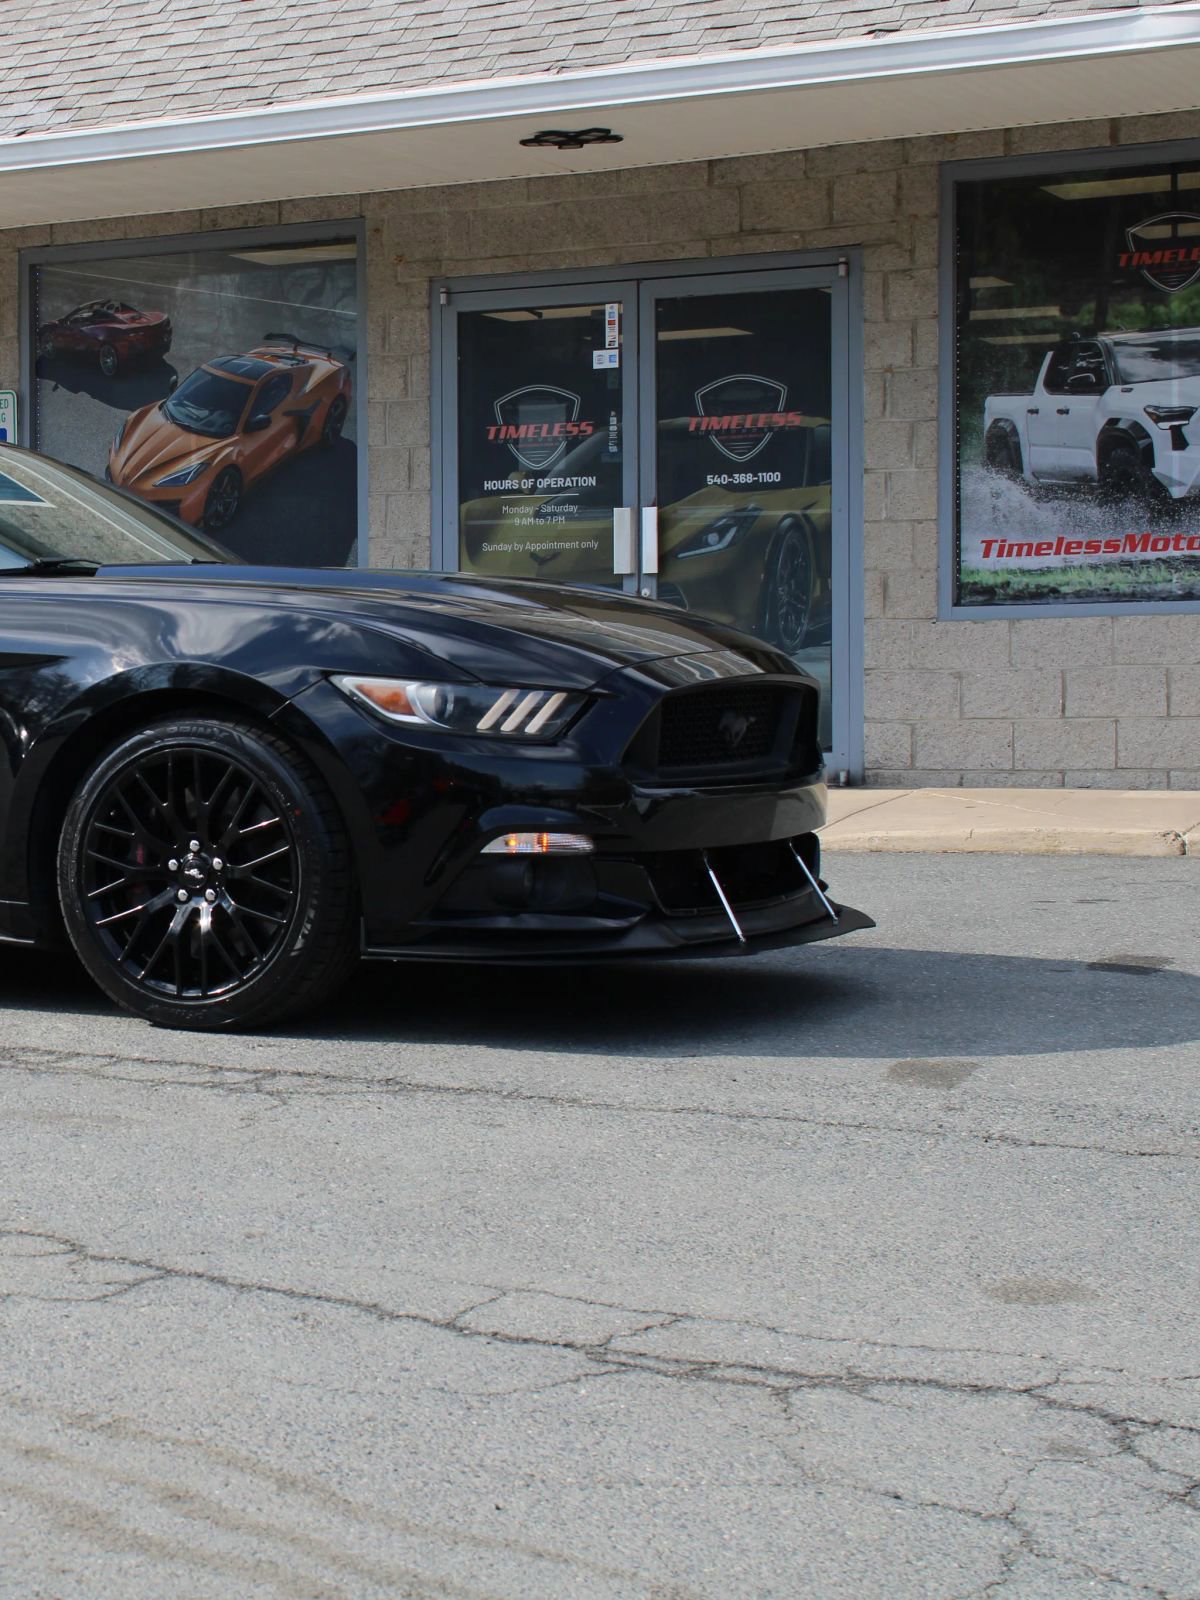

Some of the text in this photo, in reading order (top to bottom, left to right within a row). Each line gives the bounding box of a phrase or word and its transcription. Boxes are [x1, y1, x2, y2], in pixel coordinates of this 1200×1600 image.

[687, 411, 802, 432] TIMELESS
[486, 421, 595, 440] TIMELESS
[483, 476, 597, 490] HOURS OF OPERATION
[706, 472, 781, 485] 540-368-1100
[502, 505, 534, 515] Monday
[540, 503, 578, 514] Saturday
[514, 515, 566, 526] 9 AM to 7 PM
[482, 540, 599, 552] Sunday by Appointment only
